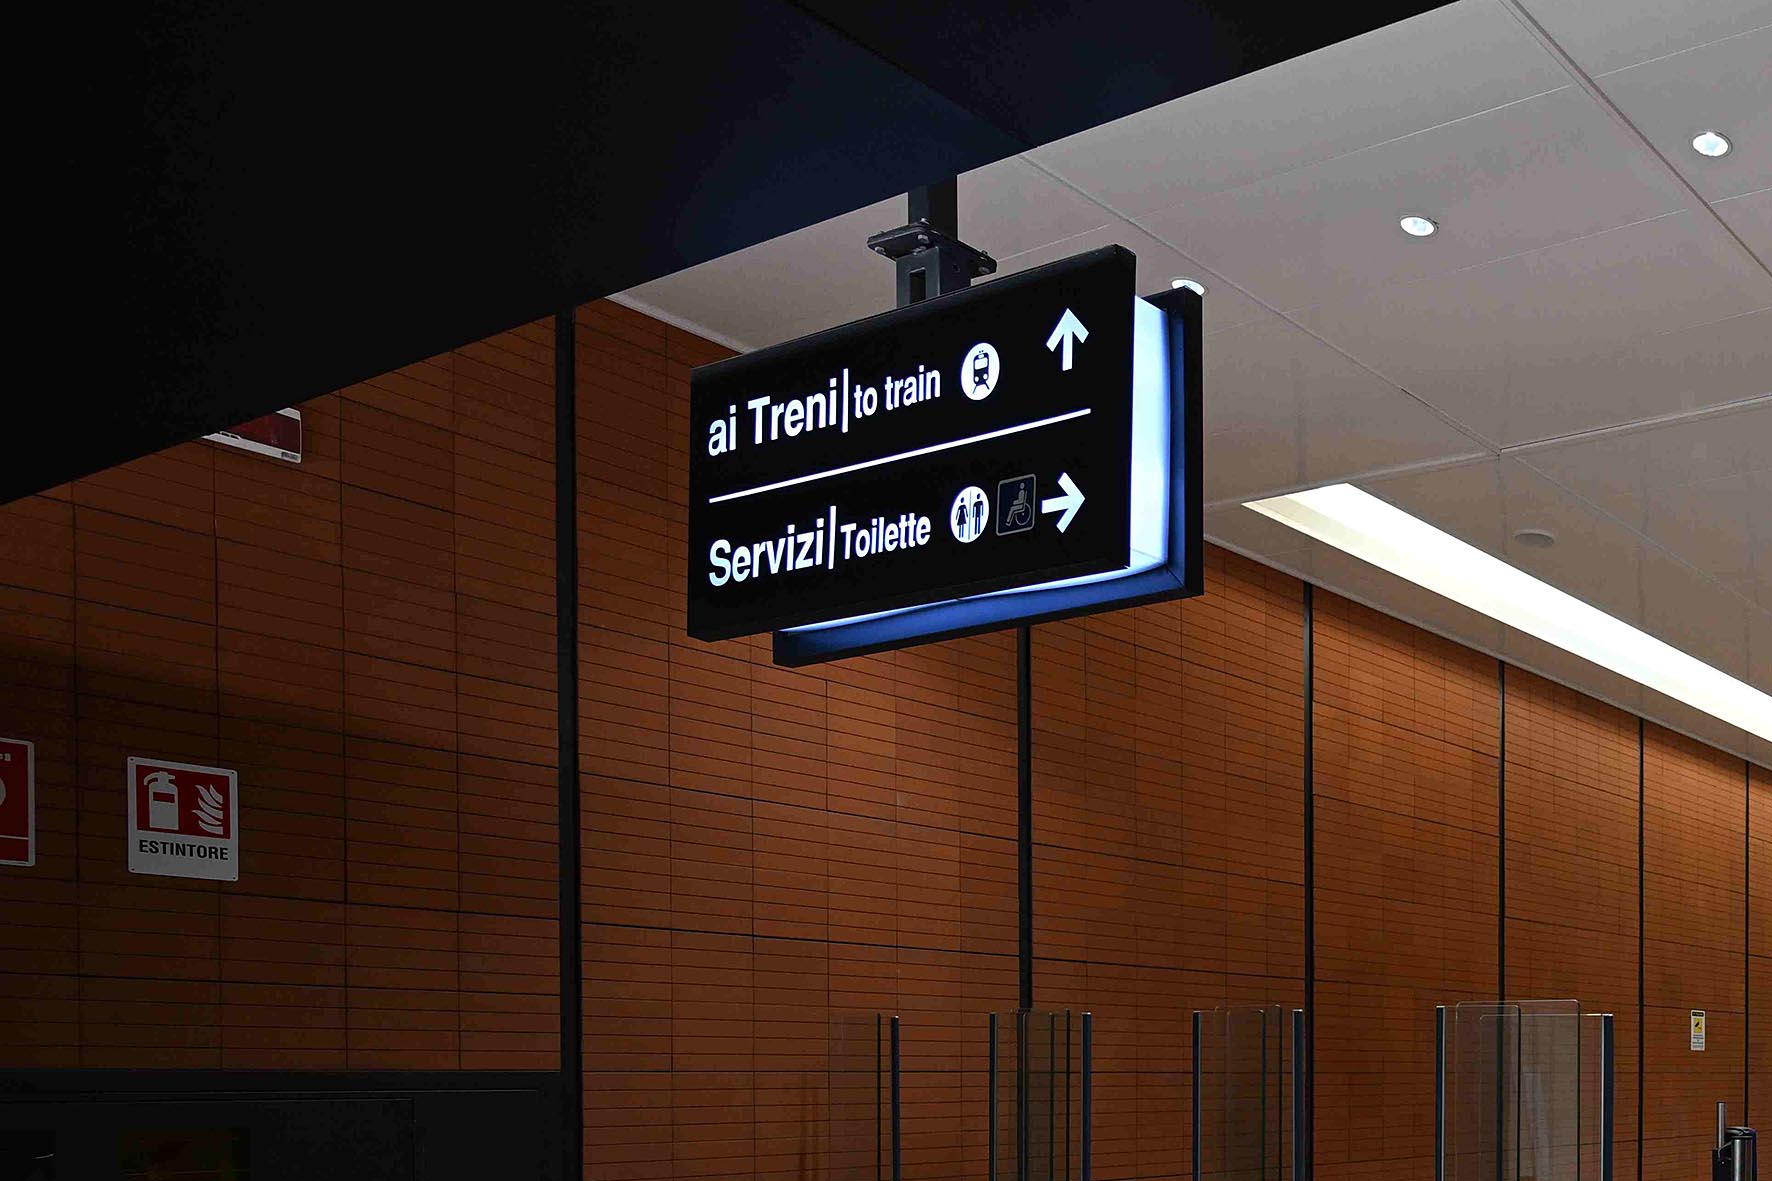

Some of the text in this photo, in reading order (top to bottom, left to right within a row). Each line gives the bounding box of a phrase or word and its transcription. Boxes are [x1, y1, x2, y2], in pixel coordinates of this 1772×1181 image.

[708, 364, 941, 457] ai Treni to train
[708, 512, 932, 587] Servizi Toilette
[138, 839, 229, 861] ESTINTORE
